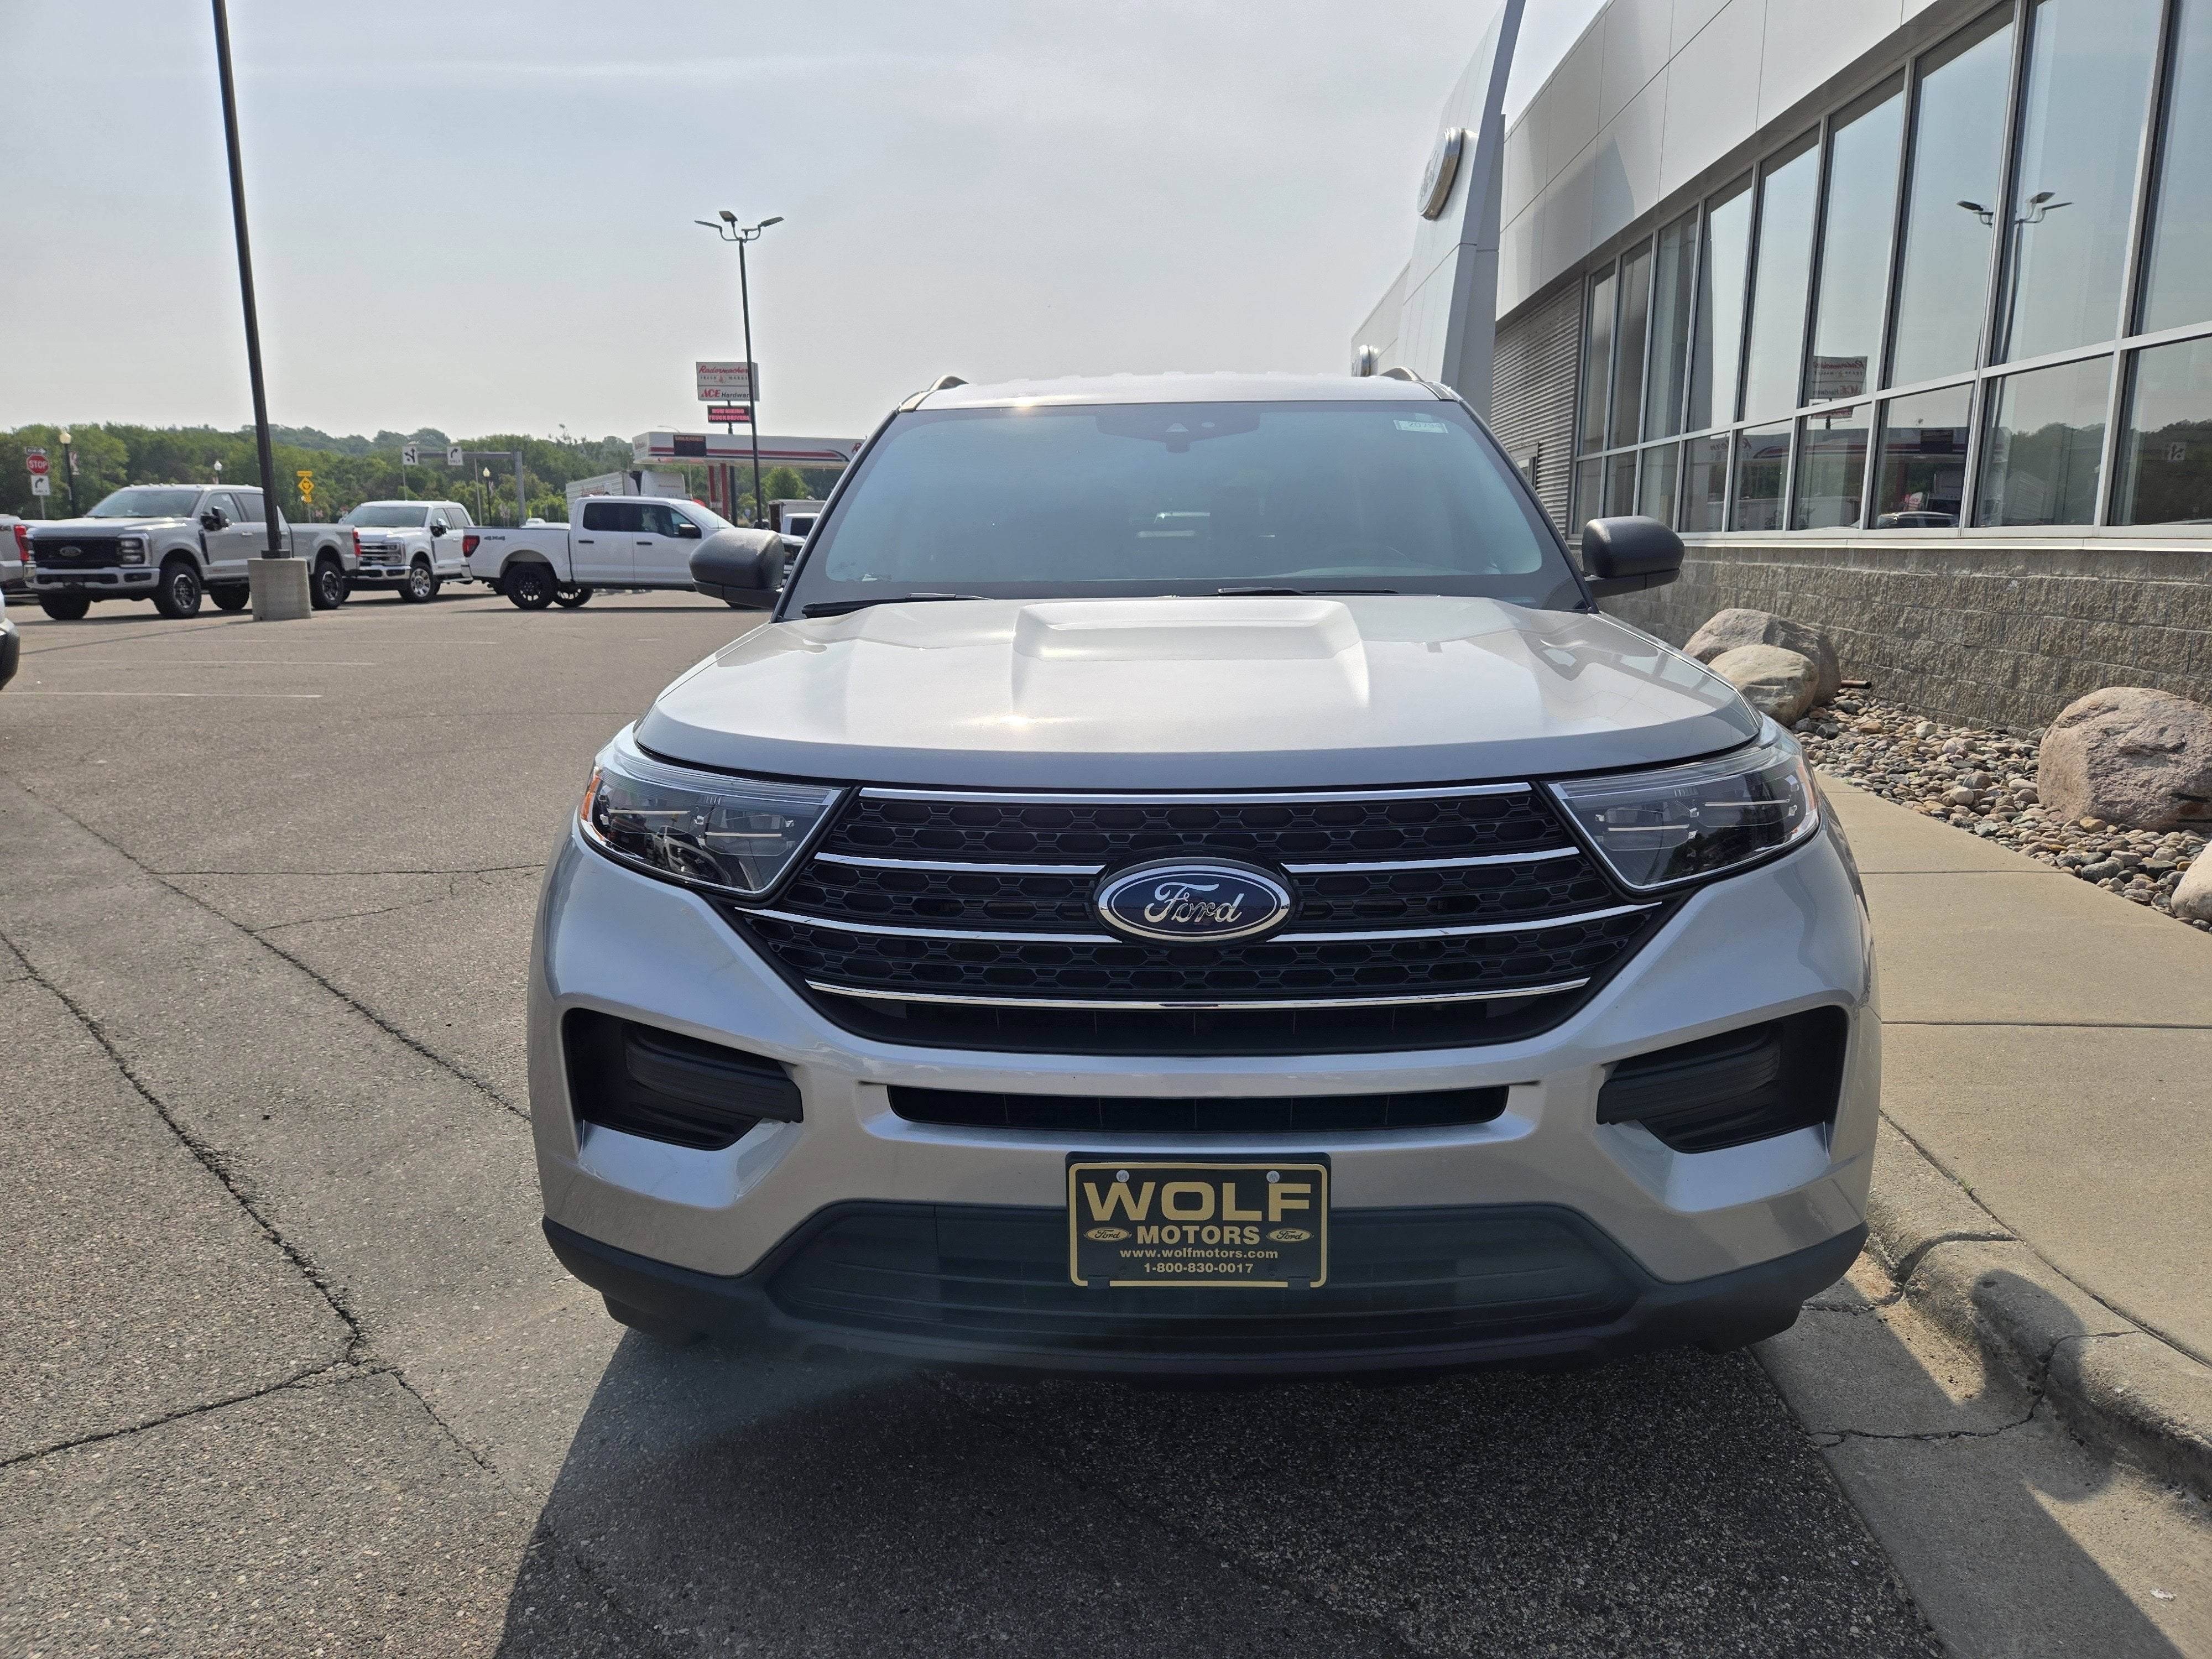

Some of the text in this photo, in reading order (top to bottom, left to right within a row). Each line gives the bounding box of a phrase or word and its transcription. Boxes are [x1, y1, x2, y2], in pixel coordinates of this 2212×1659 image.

[698, 365, 748, 373] Radermacher
[701, 388, 721, 398] ACE
[28, 460, 48, 469] STOP
[1144, 881, 1244, 922] Ford
[1083, 1181, 1312, 1222] WOLF
[1094, 1229, 1120, 1239] Ford
[1137, 1225, 1260, 1245] MOTORS
[1276, 1230, 1303, 1240] Ford
[1120, 1248, 1279, 1259] www.wolfmotors.com
[1144, 1262, 1254, 1274] 1-800-830-0017
